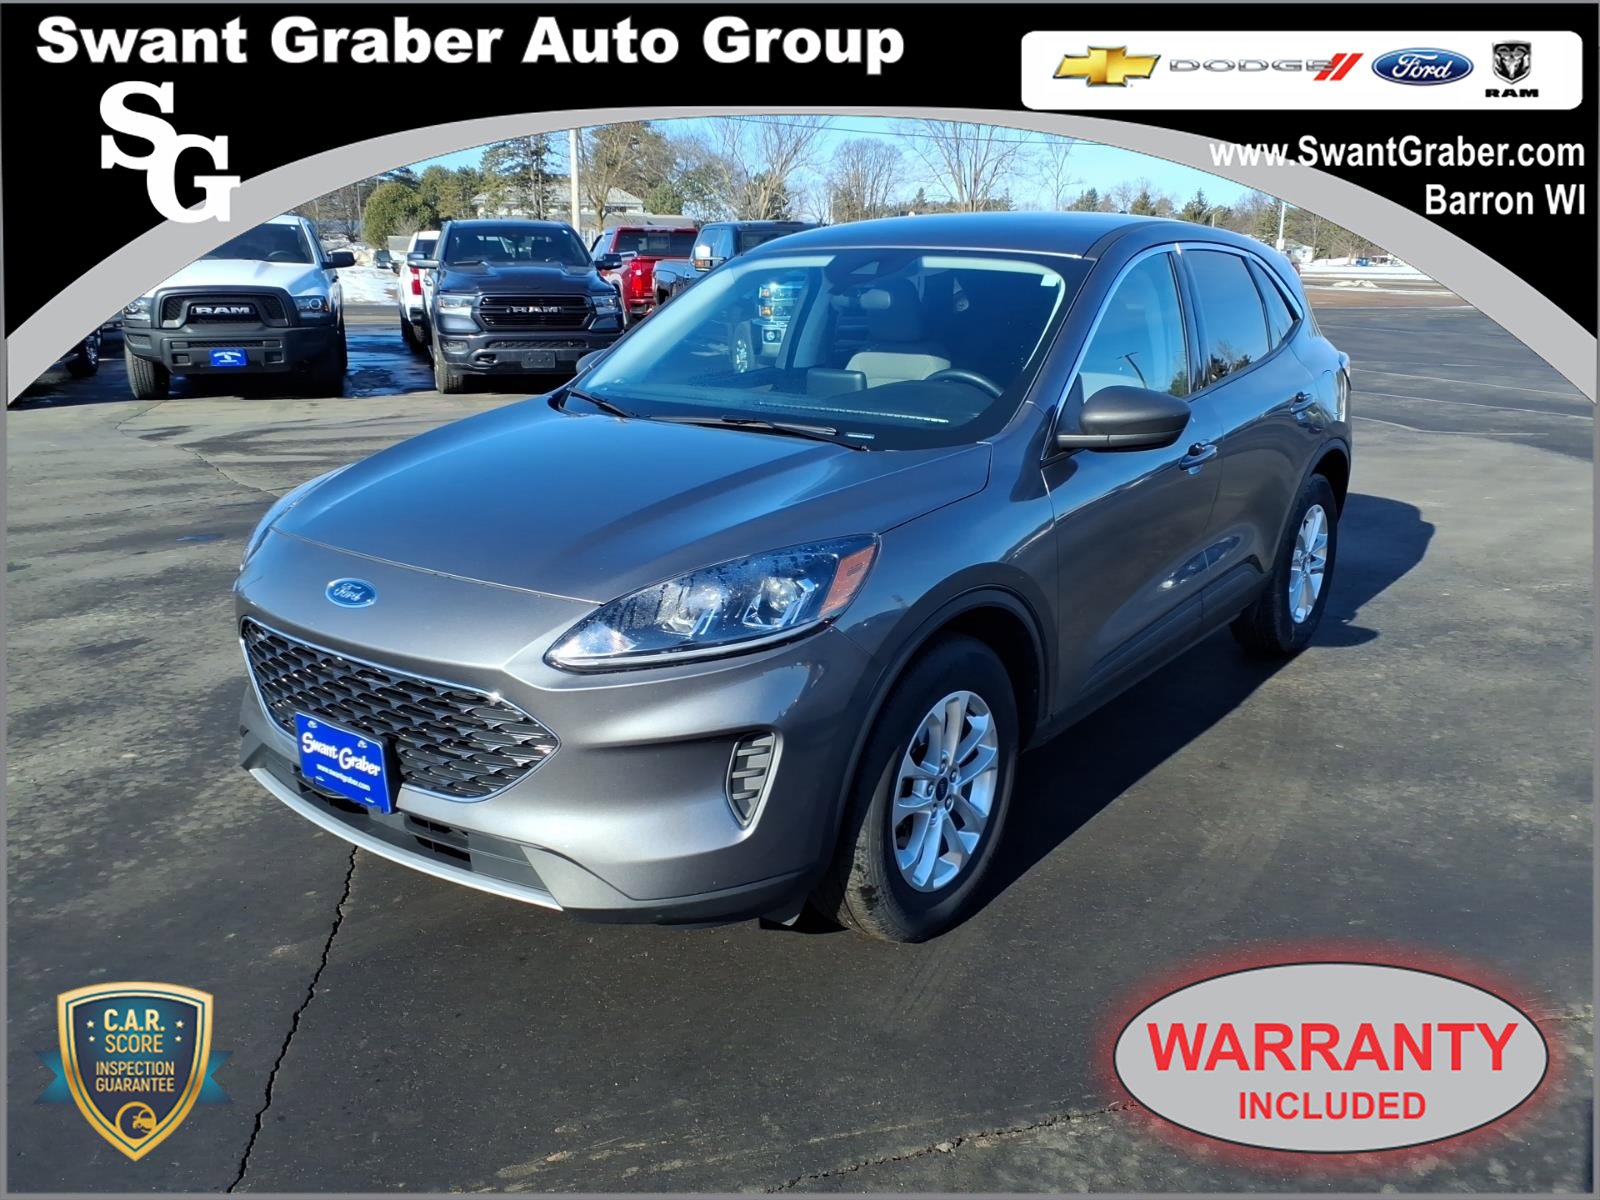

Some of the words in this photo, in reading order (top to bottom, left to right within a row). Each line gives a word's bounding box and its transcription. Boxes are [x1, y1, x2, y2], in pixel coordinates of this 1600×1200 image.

[194, 306, 251, 315] RAM
[510, 305, 561, 314] RAM
[333, 582, 364, 601] Ford
[302, 732, 338, 760] Swant
[339, 747, 381, 776] Graber
